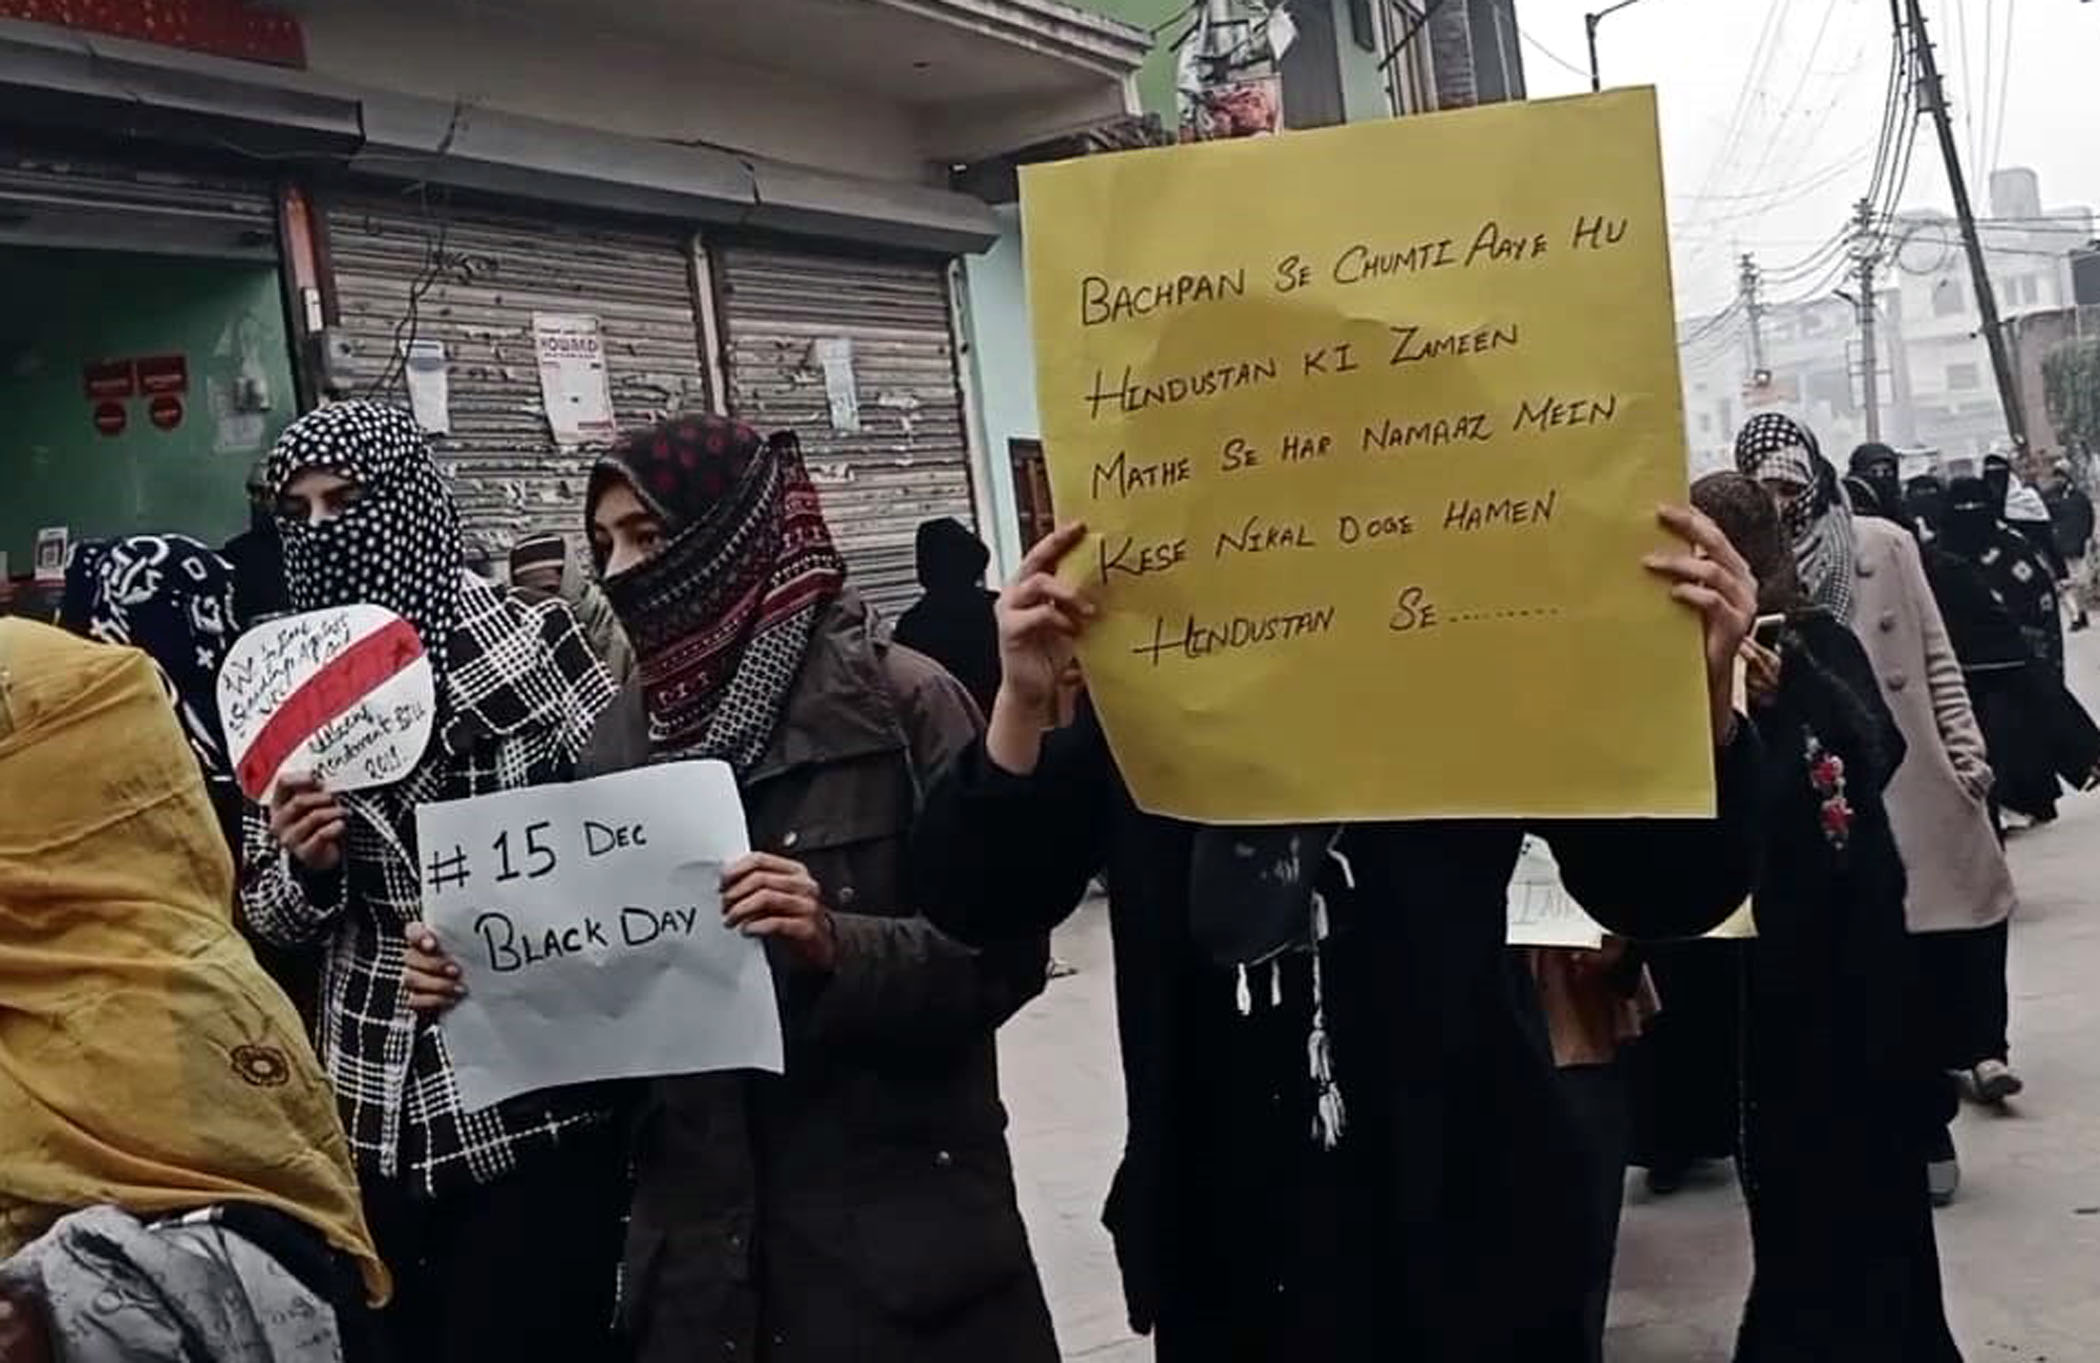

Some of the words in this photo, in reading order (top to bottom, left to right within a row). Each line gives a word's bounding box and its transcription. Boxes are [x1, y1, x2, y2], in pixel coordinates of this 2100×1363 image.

[1082, 269, 1244, 326] BACHPAN
[1275, 255, 1310, 293] SE
[1333, 239, 1455, 284] CHUMTI
[1464, 222, 1547, 267] AAYE
[1573, 216, 1627, 249] HU
[1084, 358, 1276, 419] HINDUSTAN
[1305, 344, 1358, 374] KI
[1390, 324, 1518, 365] ZAMEEN
[1093, 451, 1189, 500] MATHE
[1221, 439, 1258, 471] SE
[1363, 415, 1492, 451] NAMAAZ
[1513, 394, 1616, 432] MEIN
[1100, 537, 1187, 585] KESE
[1444, 490, 1556, 531] HAMEN
[1132, 606, 1334, 666] HINDUSTAN
[428, 844, 471, 894] #
[492, 821, 556, 882] 15
[583, 821, 647, 857] DEC
[474, 912, 608, 972] BLACK
[620, 907, 696, 946] DAY
